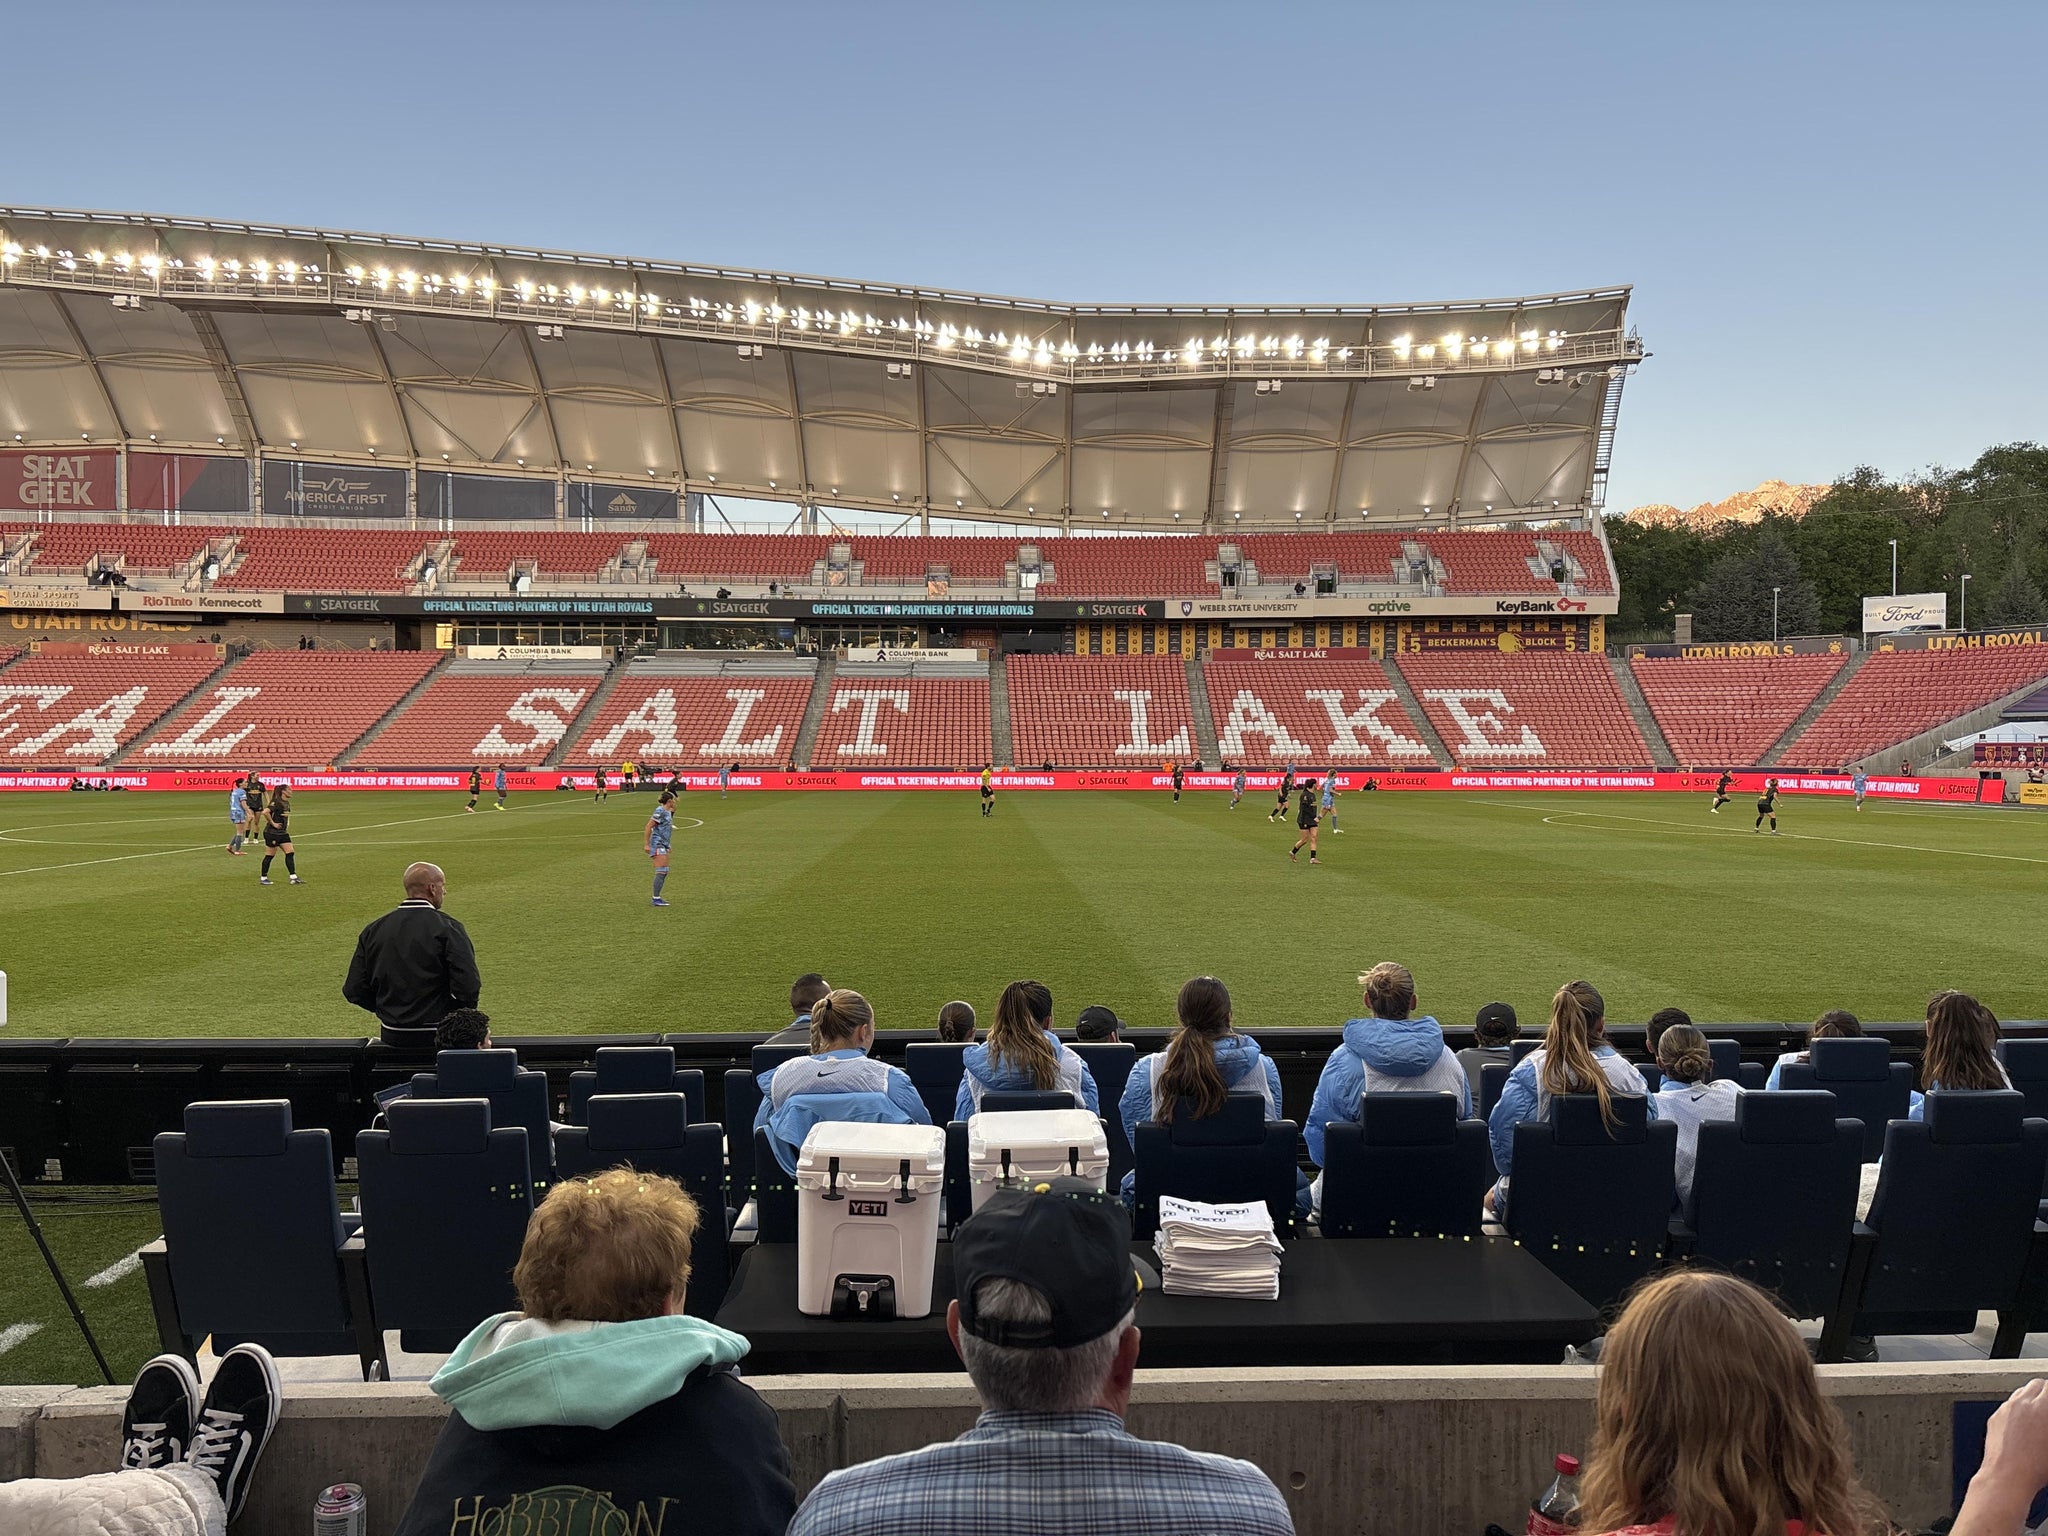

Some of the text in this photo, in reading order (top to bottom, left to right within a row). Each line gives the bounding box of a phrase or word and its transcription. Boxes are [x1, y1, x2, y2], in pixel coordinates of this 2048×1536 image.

[22, 454, 91, 479] SEAT
[19, 481, 94, 505] GEEK
[284, 490, 387, 505] AMERICA FIRST
[608, 504, 637, 514] Sandy
[13, 591, 80, 600] UTAH SPORTS
[12, 600, 79, 608] COMMISSION
[199, 597, 262, 608] Kennecott
[320, 598, 380, 612] SEATGEEK
[423, 600, 653, 613] OFFICIAL TICKETING PARTNER OF THE UTAH ROYALS
[1199, 603, 1298, 612] WEBER STATE UNIVERSITY
[1368, 599, 1411, 615] aptive
[1496, 601, 1555, 614] KeyBank
[713, 602, 770, 615] SEATGEEK
[812, 604, 1034, 616] OFFICIAL TICKETING PARTNER OF THE UTAH ROYALS
[1092, 604, 1148, 616] SEATGEEK
[1882, 605, 1924, 622] Ford
[11, 613, 82, 630] UTAH
[1410, 637, 1576, 653] 5 BECKERMAN'S BLOCK 5
[1928, 635, 1981, 650] UTAH
[115, 646, 140, 655] SALT
[142, 646, 169, 655] LAKE
[1278, 650, 1301, 659] SALT
[1303, 650, 1328, 659] LAKE
[1681, 644, 1794, 659] UTAH ROYALS
[472, 688, 910, 757] SALT
[1114, 689, 1547, 758] LAKE
[16, 777, 56, 786] PARTNER
[58, 777, 70, 786] OF
[90, 777, 112, 787] UTH
[114, 777, 147, 787] ROYALS
[187, 776, 230, 786] SEATGEEK
[259, 776, 292, 786] FFICIAL
[293, 776, 337, 786] TICKETING
[338, 776, 377, 786] PARTNER
[377, 776, 389, 786] OF
[389, 776, 405, 786] THE
[405, 776, 427, 786] UTAH
[428, 776, 460, 786] ROYALS
[505, 776, 537, 786] ATGEEK
[692, 776, 708, 786] THE
[730, 776, 761, 786] ROYALS
[797, 776, 838, 786] SEATGEEK
[861, 776, 896, 786] OFFICIAL
[897, 776, 939, 786] TICKETING
[939, 776, 975, 786] PARTNER
[1003, 776, 1024, 786] UTAH
[1024, 776, 1055, 786] ROYALS
[1089, 776, 1129, 786] SEATGEEK
[1188, 776, 1229, 786] TICKETING
[1230, 776, 1268, 786] PTNER
[1268, 776, 1280, 786] OF
[1386, 776, 1427, 786] SEATGEEK
[1452, 776, 1655, 787] OFFICIAL TICKETING PARTNER OF THE UTAH ROYALS
[1694, 777, 1738, 787] SEATK
[1764, 778, 1854, 791] OICIAL TICKETING PARTN
[1866, 781, 1920, 793] THE UTAH ROYALS
[851, 1202, 885, 1215] YETI
